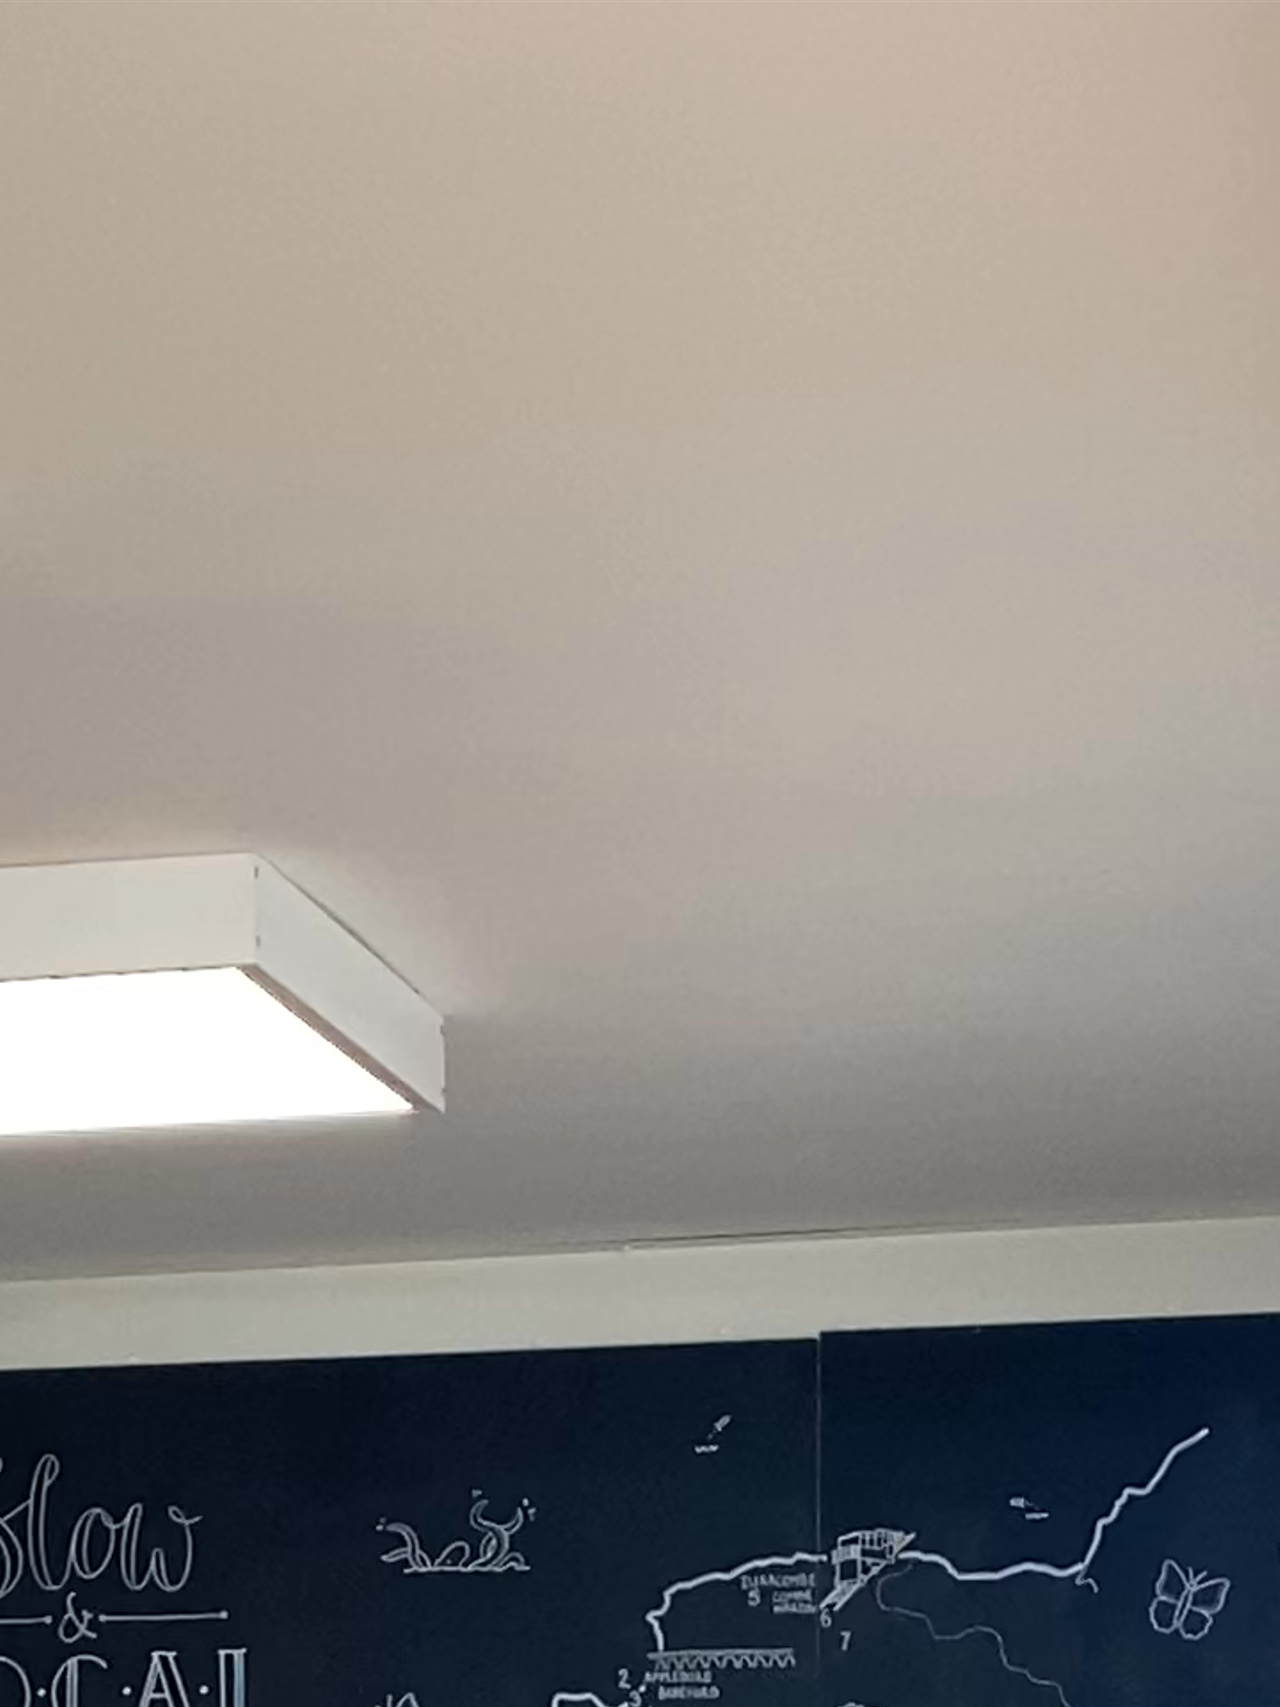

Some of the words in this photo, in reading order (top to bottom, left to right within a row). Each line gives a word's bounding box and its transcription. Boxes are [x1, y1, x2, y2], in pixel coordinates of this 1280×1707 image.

[58, 1591, 98, 1645] &
[819, 1610, 832, 1628] 6
[839, 1630, 852, 1651] 7
[618, 1668, 631, 1689] 2
[629, 1689, 641, 1707] 3
